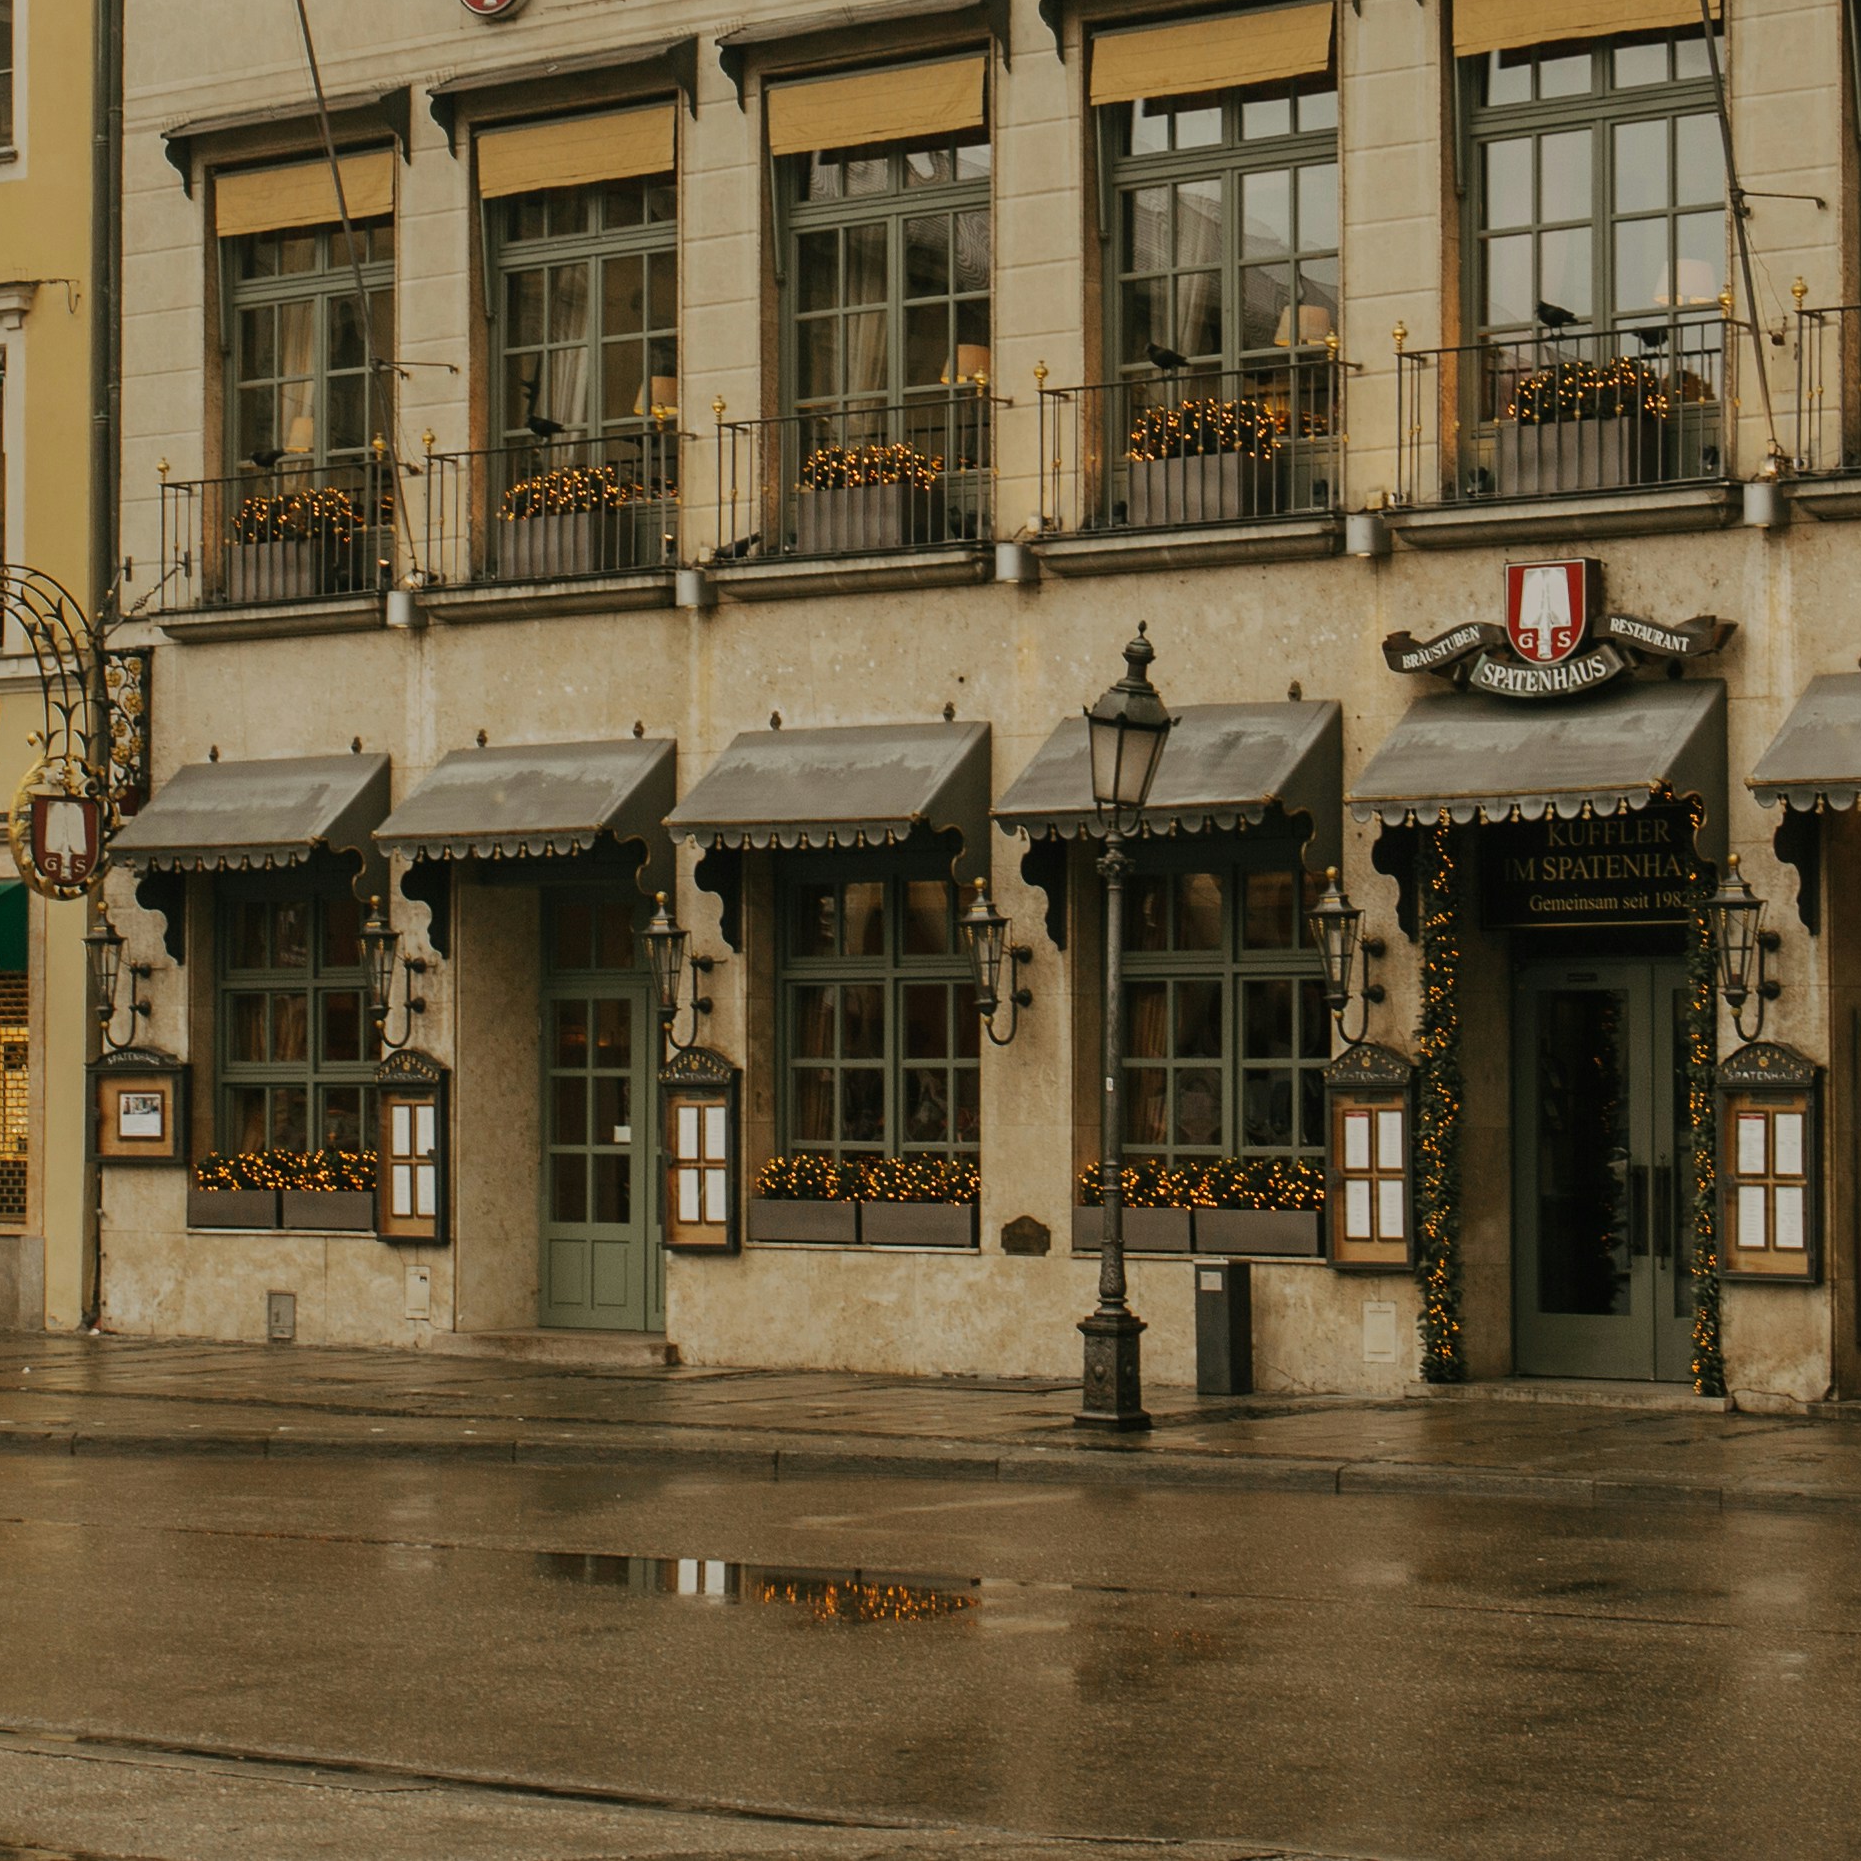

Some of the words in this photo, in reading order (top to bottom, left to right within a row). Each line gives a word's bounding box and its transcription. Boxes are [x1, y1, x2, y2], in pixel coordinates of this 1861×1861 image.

[1401, 625, 1481, 670] BRÄUSTUBEN
[1518, 633, 1534, 649] G
[1557, 631, 1572, 648] S
[1609, 617, 1690, 653] RESTAURANT
[1480, 655, 1607, 693] SPATENHAUS
[1547, 819, 1672, 847] KUFFLER
[44, 857, 58, 871] G
[74, 859, 87, 873] S
[1504, 857, 1536, 882] IM
[1542, 852, 1688, 882] SPATENHA
[1529, 894, 1619, 913] Gemeinsam
[1622, 893, 1650, 910] seit
[1728, 1070, 1802, 1081] SPATENHAUS
